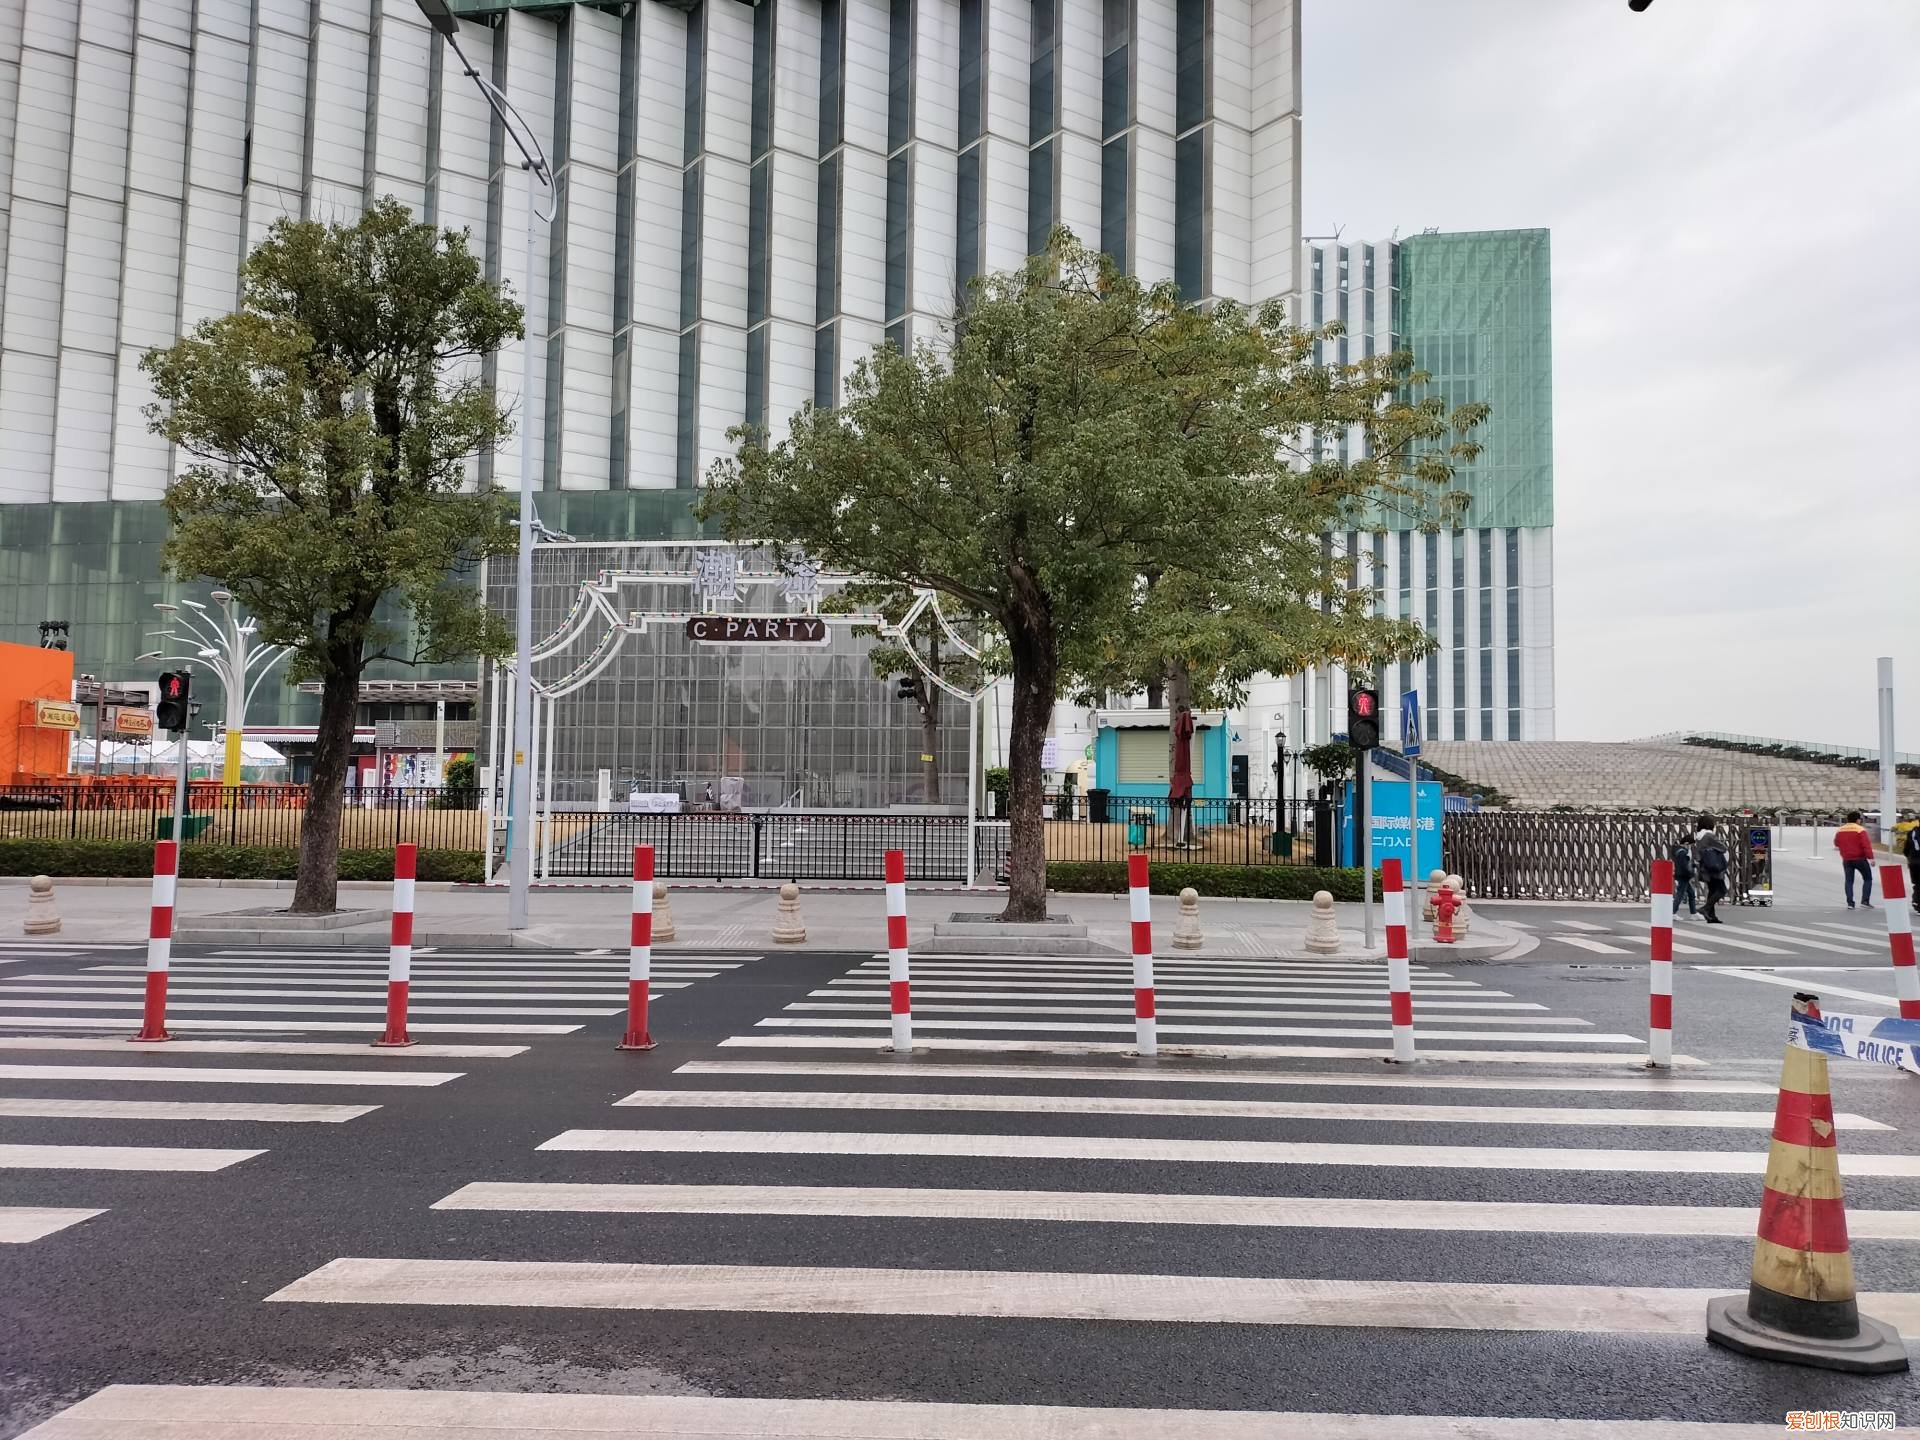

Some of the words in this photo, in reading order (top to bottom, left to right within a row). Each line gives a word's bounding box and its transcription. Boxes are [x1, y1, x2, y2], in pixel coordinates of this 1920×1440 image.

[1343, 815, 1435, 831] 广国际媒体港
[1857, 1041, 1904, 1067] POLICE
